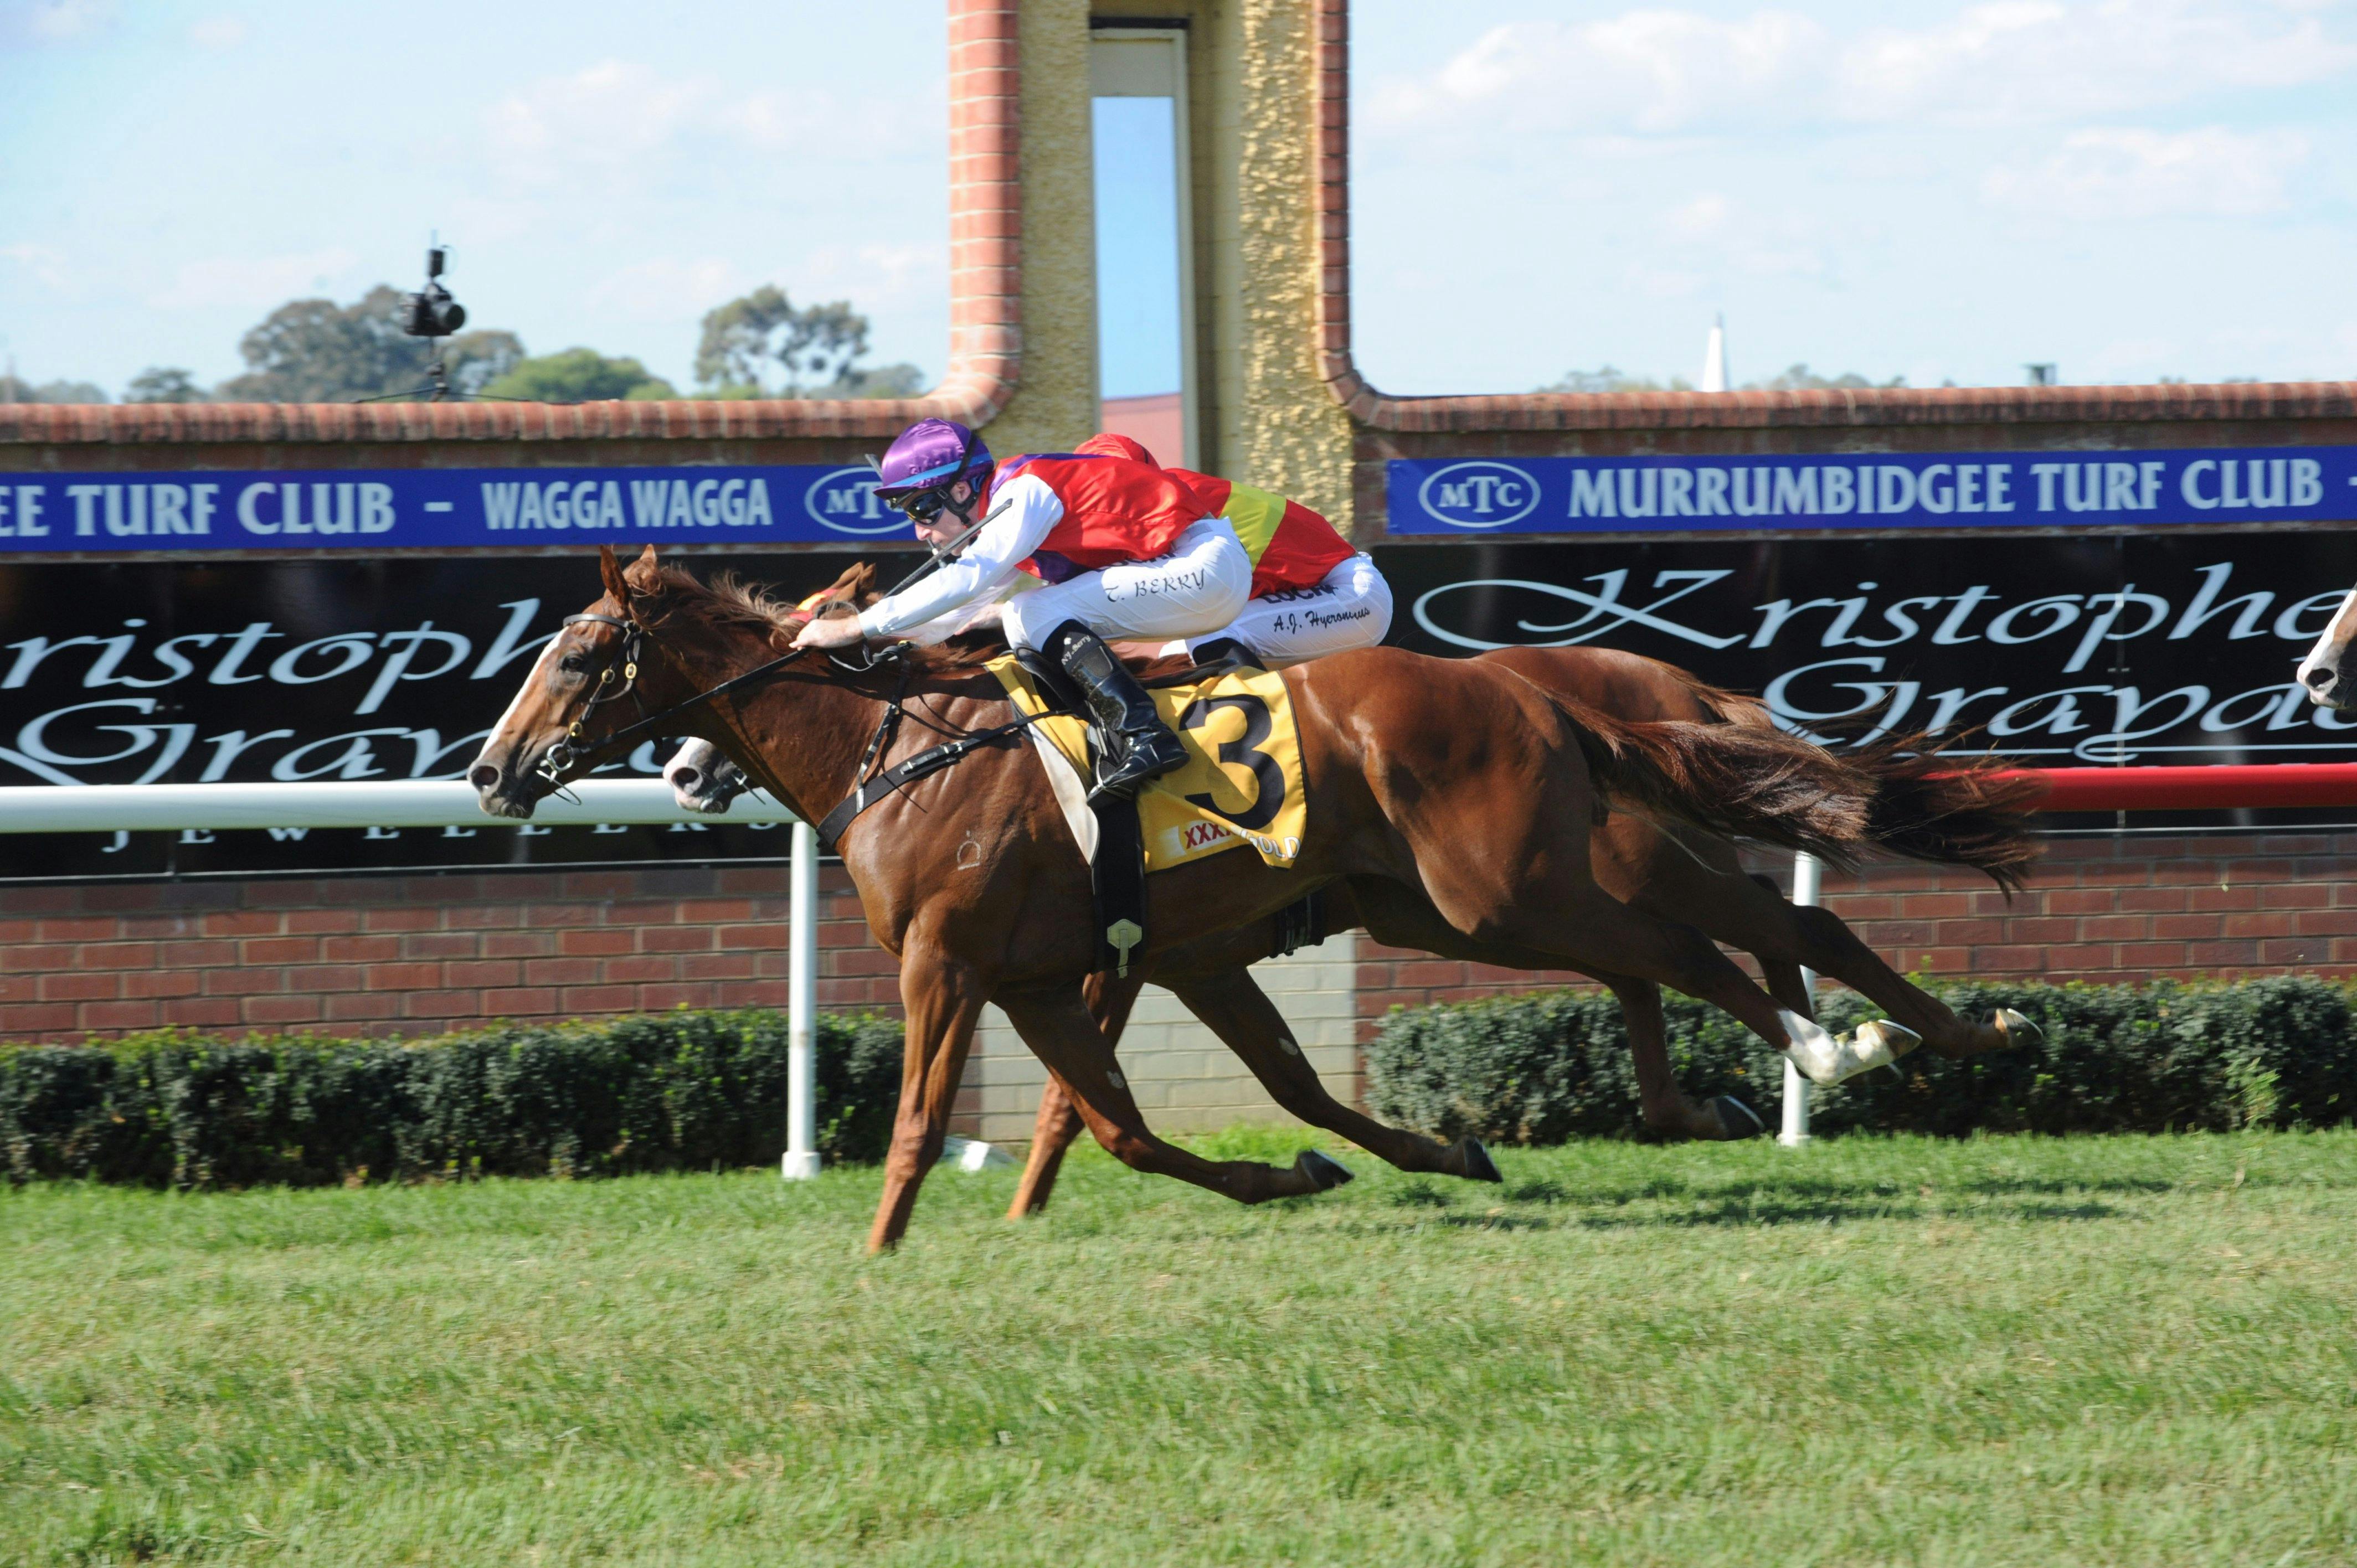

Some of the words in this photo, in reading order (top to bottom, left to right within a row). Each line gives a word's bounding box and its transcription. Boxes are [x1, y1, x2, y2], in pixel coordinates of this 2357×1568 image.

[67, 484, 218, 535] TURF
[238, 482, 395, 534] CLUB
[481, 481, 625, 529] WAGGA
[630, 478, 773, 527] WAGGA
[1437, 476, 1523, 513] MTC
[1567, 464, 2016, 518] MURRUMBIDGEE
[2030, 461, 2166, 512] TURF
[2180, 458, 2324, 509] CLUB
[1134, 568, 1205, 597] BERRY
[1179, 694, 1285, 831] 3
[1184, 823, 1232, 849] XXX
